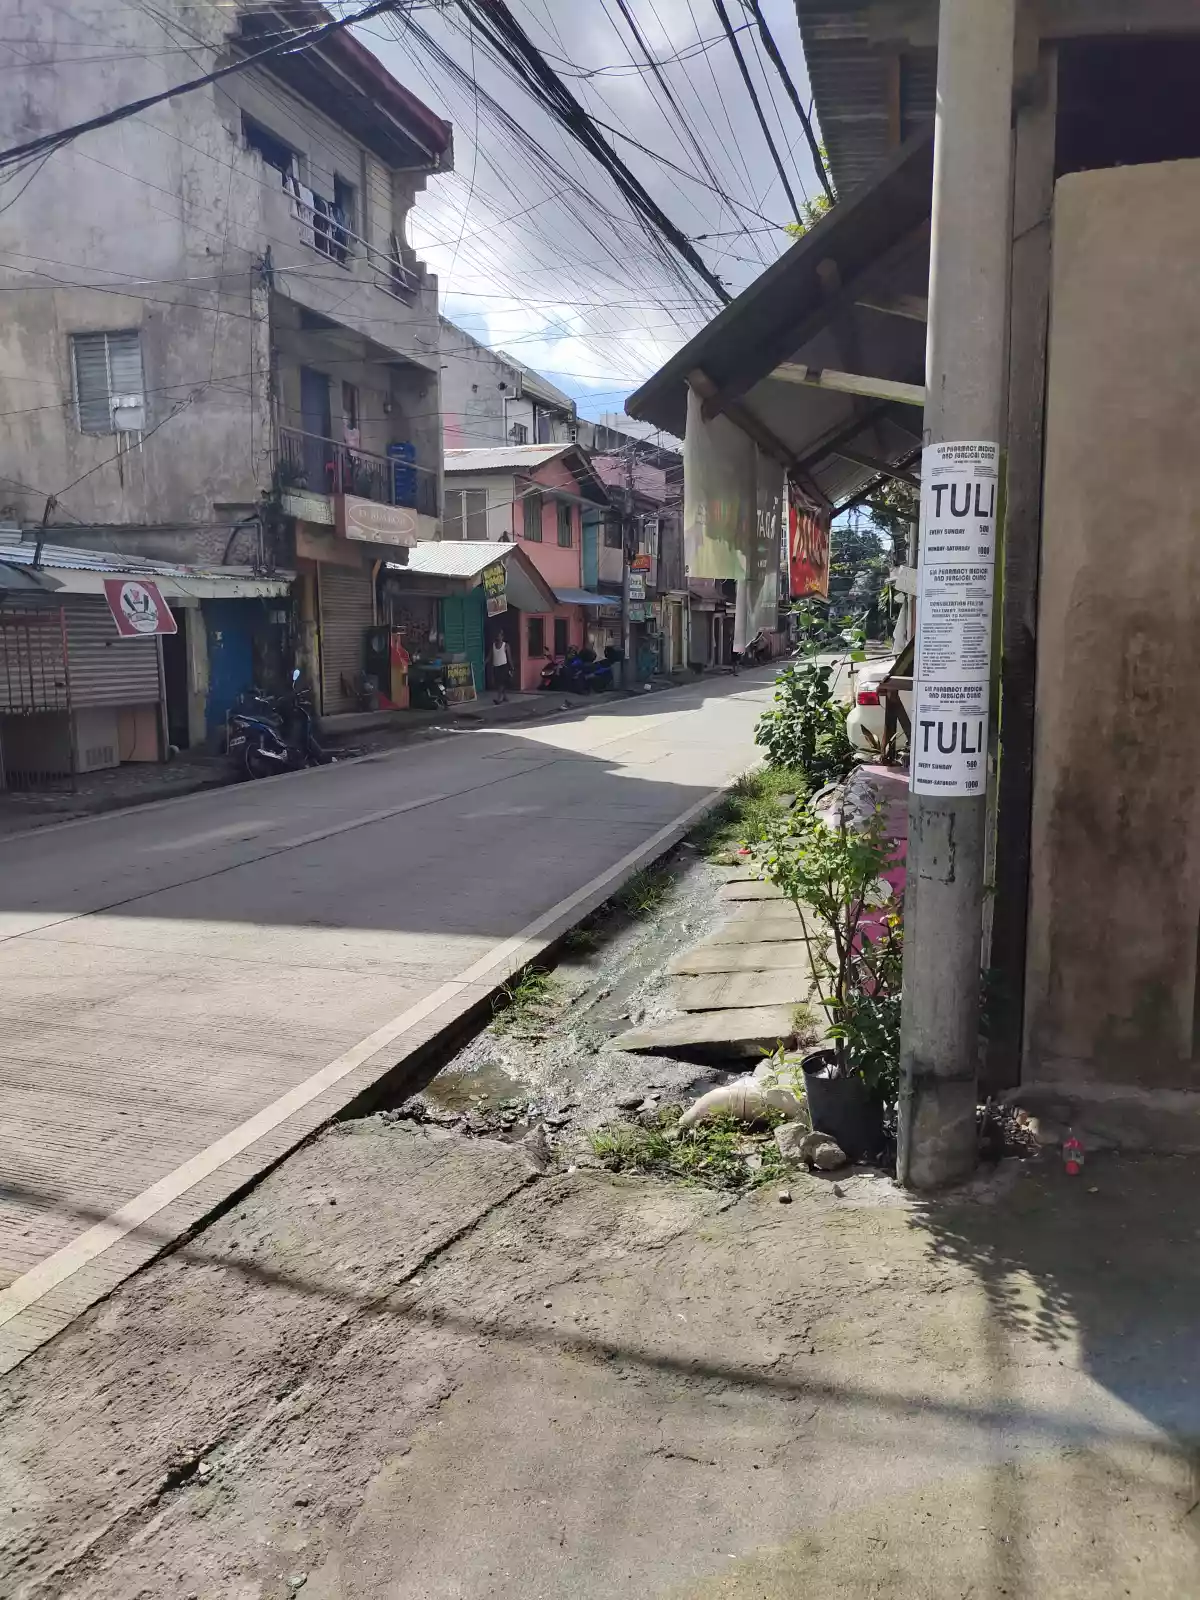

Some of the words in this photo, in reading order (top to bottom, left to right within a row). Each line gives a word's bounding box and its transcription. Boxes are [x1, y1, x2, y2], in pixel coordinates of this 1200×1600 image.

[931, 483, 994, 518] TULI
[979, 524, 990, 533] 500
[919, 720, 983, 754] TULI
[966, 760, 978, 768] 500
[965, 780, 979, 789] 1000
